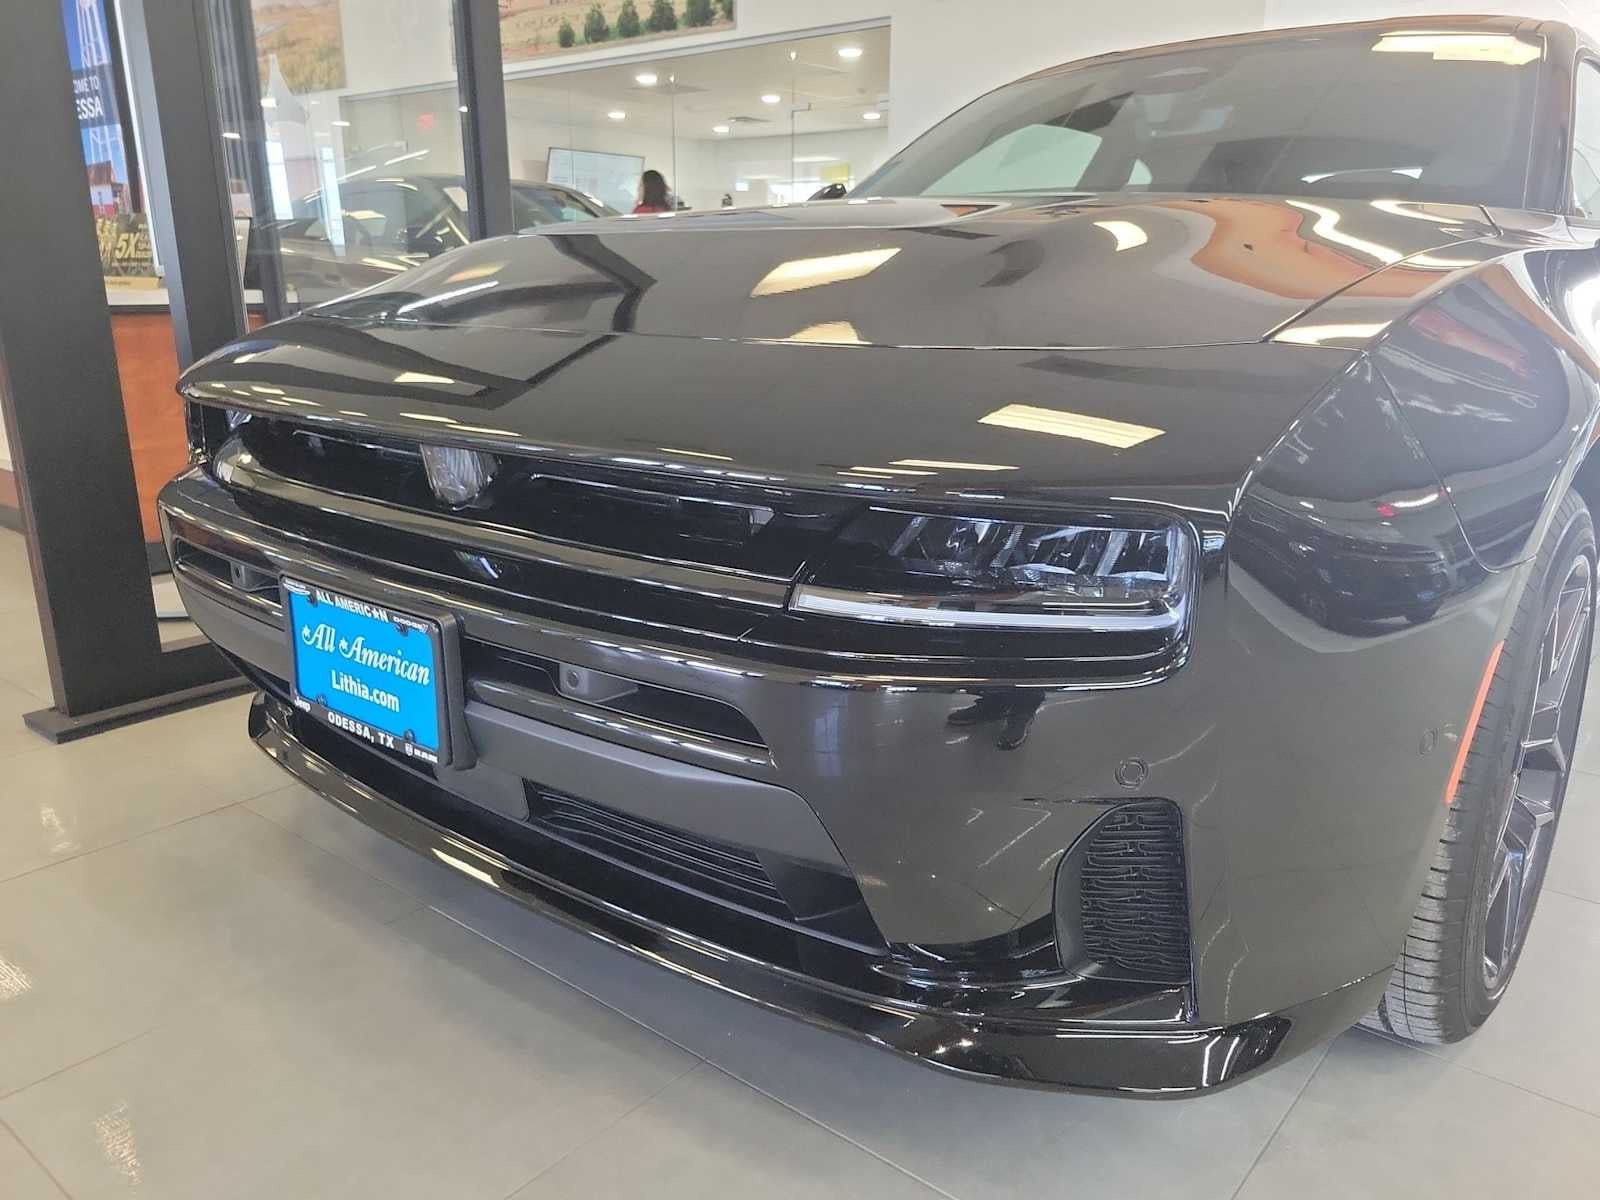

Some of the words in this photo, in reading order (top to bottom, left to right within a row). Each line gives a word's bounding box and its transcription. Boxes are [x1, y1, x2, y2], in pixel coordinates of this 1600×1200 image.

[316, 590, 334, 605] ALL
[302, 623, 336, 653] All
[339, 636, 431, 685] American
[331, 670, 400, 712] Lithia.com
[328, 712, 375, 743] ODESSA,
[378, 732, 394, 749] TX
